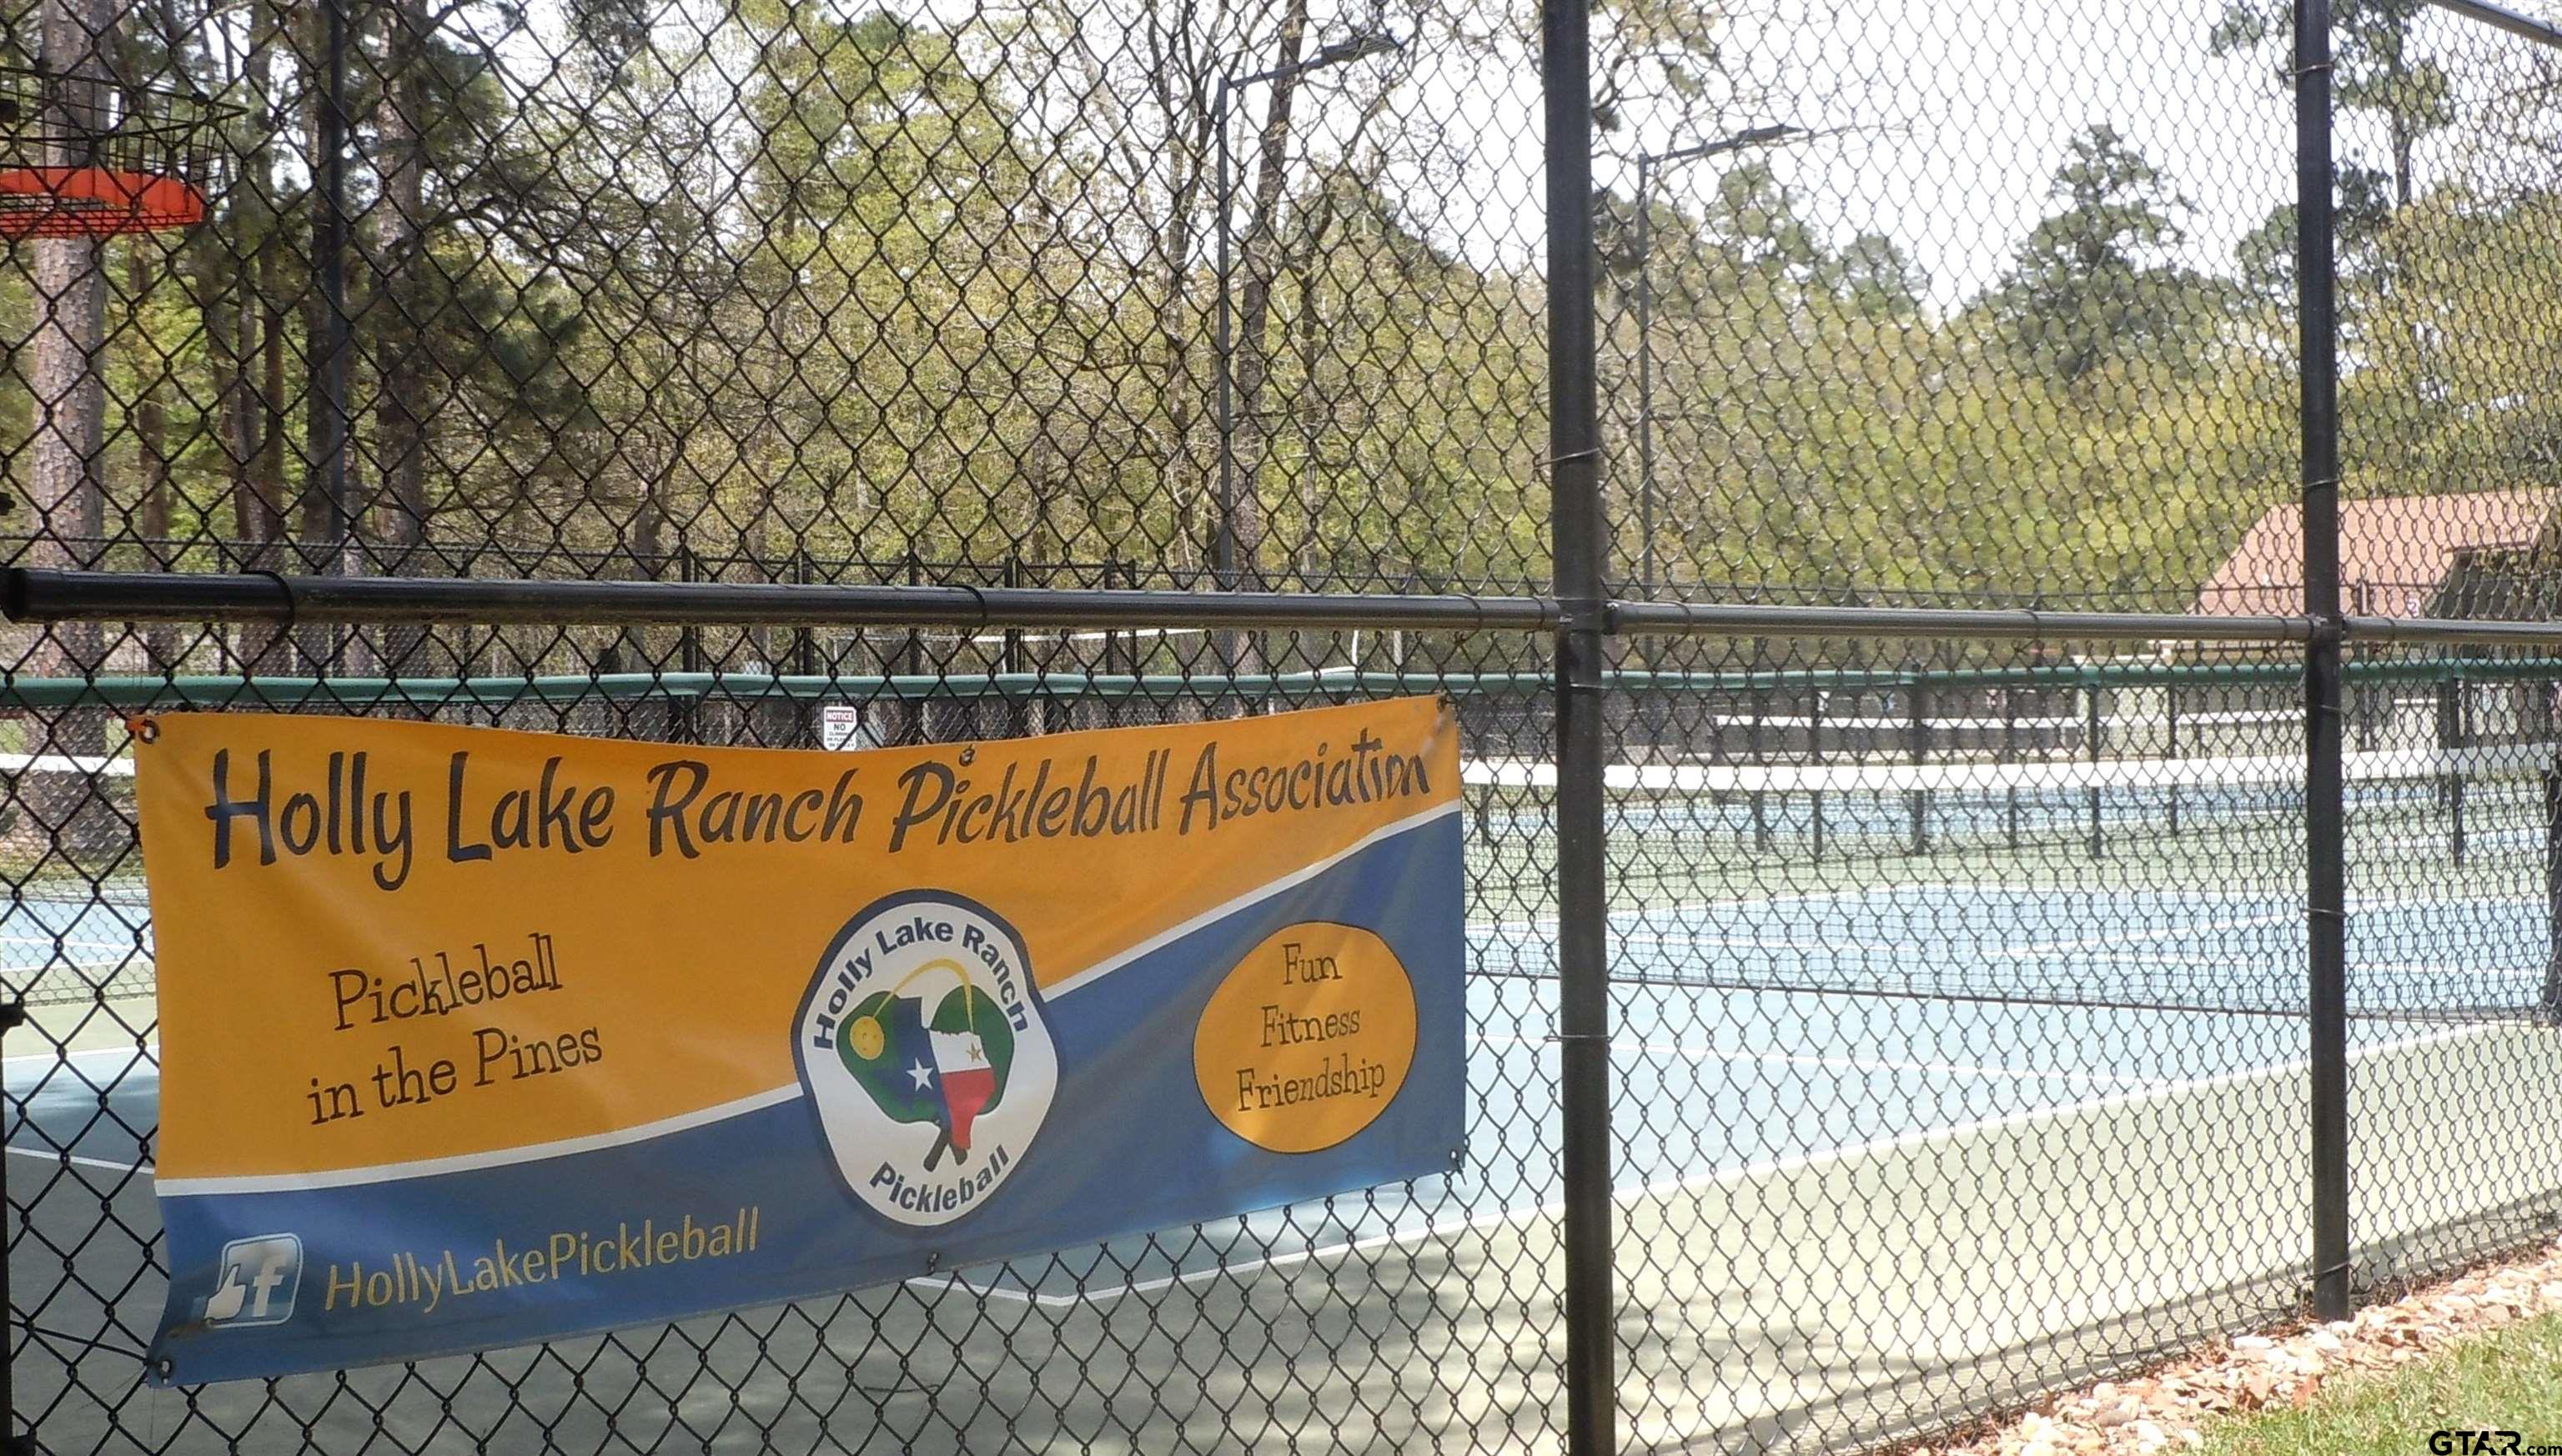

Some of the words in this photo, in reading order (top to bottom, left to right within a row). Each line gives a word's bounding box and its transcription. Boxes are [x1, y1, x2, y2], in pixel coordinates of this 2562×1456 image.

[826, 711, 853, 721] NOTICE
[833, 723, 846, 731] NO
[205, 748, 411, 891] Holly
[446, 751, 615, 863] Lake
[647, 760, 864, 859] Ranch
[889, 747, 1169, 854] Pickleball
[329, 933, 564, 1031] Pickleball
[814, 948, 874, 1051] Holly
[876, 917, 954, 956] Lake
[962, 924, 1029, 1032] Ranch
[1282, 943, 1343, 986] Fun
[1260, 1005, 1361, 1047] Fitness
[306, 1078, 364, 1125] in
[371, 1047, 458, 1110] the
[472, 1025, 603, 1087] Pines
[1236, 1053, 1385, 1112] Friendship
[870, 1144, 1010, 1213] Pickleball
[324, 1206, 759, 1314] HollyLakePickleball
